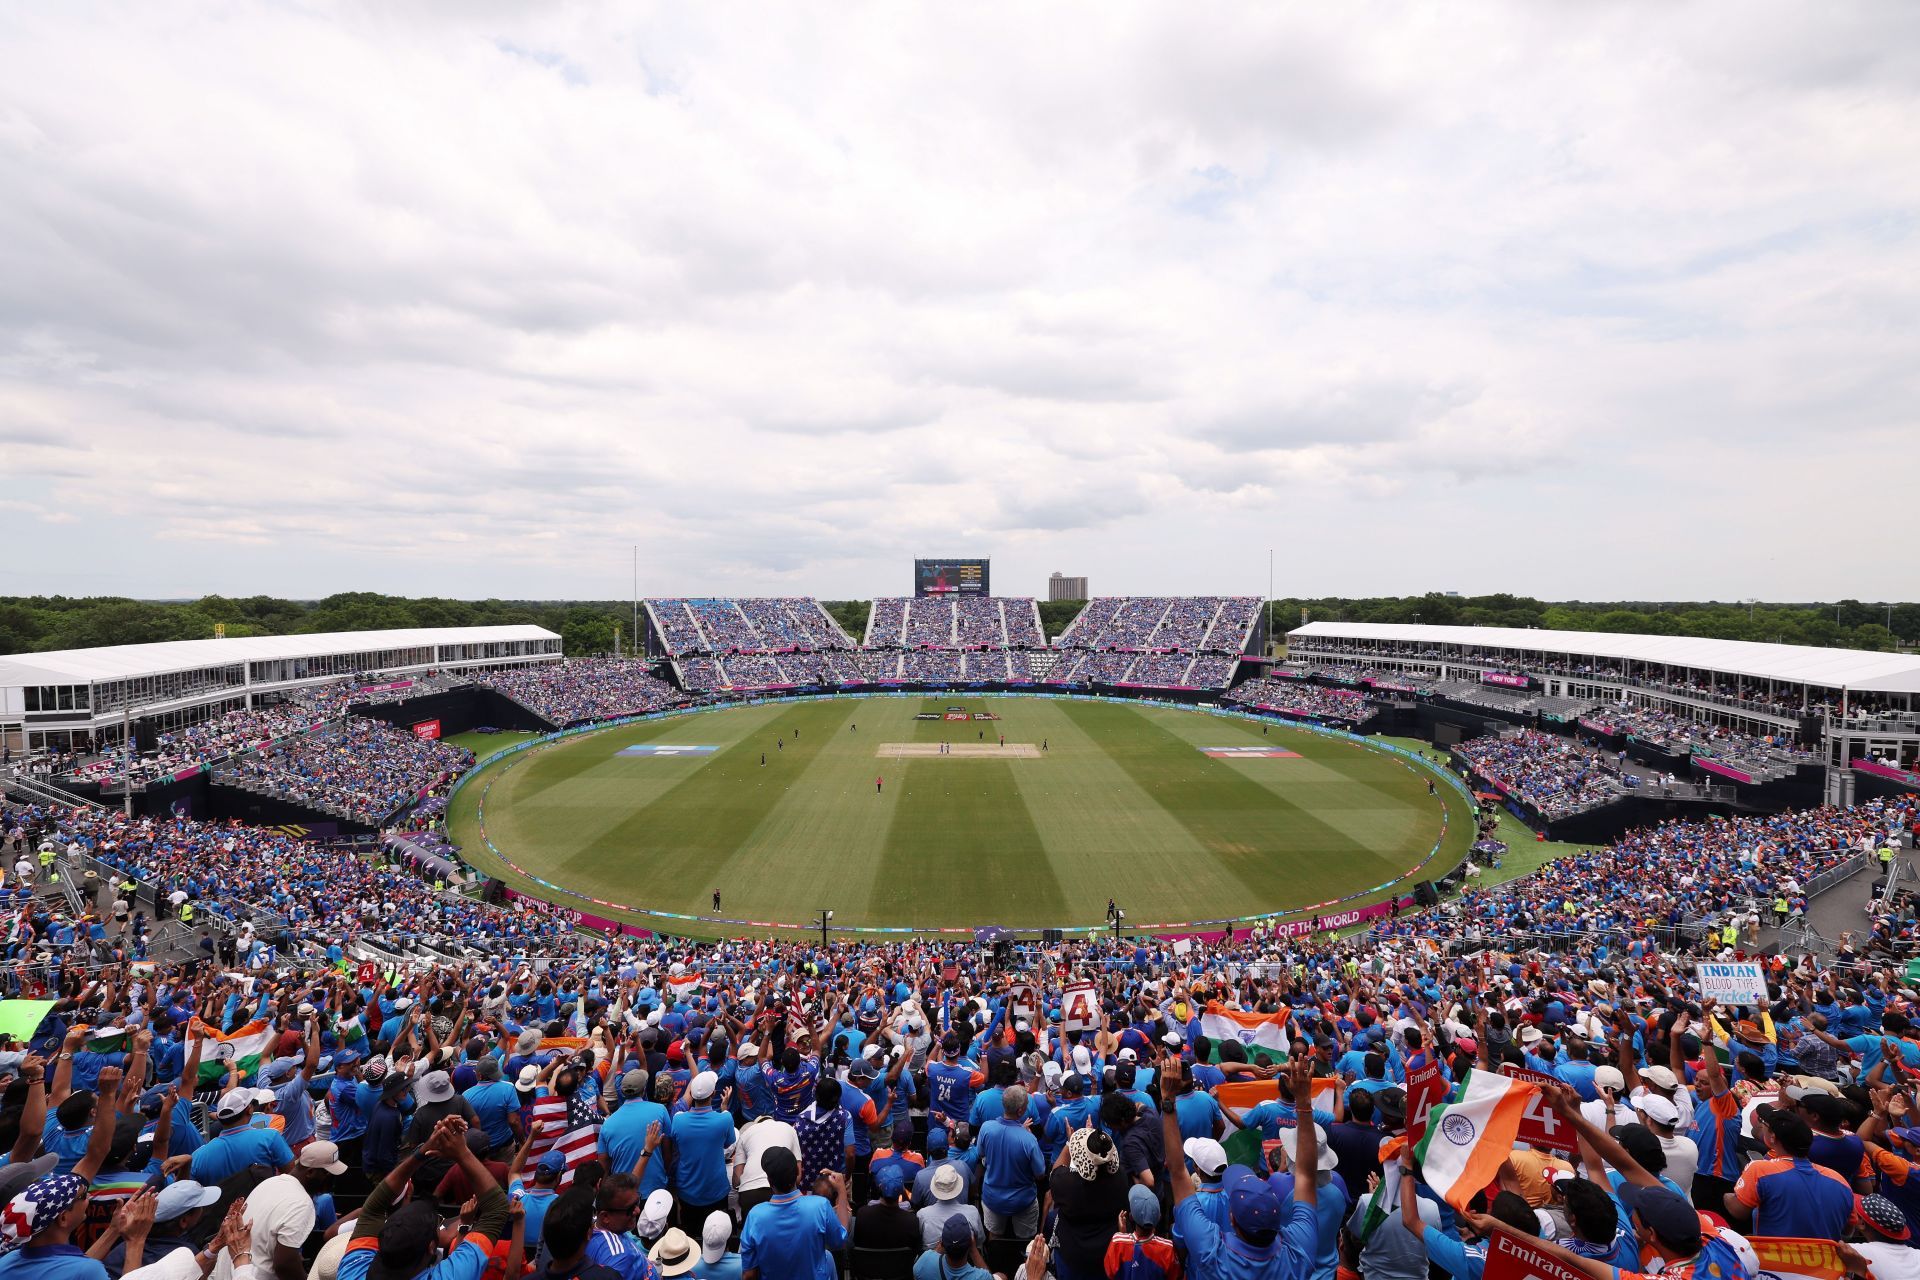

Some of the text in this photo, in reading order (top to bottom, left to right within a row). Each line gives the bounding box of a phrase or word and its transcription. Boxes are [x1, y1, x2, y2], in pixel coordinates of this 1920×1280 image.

[1491, 675, 1518, 685] NEW YORK
[417, 724, 436, 733] Emirates
[1279, 923, 1295, 936] OF
[1297, 919, 1322, 933] THS
[1323, 911, 1360, 929] WORLD
[362, 967, 370, 978] 4
[1058, 965, 1066, 974] 4
[1701, 965, 1757, 977] INDIAN
[1704, 977, 1758, 990] BLOOD TYPE:
[1017, 988, 1035, 1011] 4
[1068, 994, 1092, 1026] 4
[936, 1075, 957, 1085] VIJAY
[1410, 1065, 1438, 1086] Emirates
[938, 1083, 951, 1102] 24
[1413, 1086, 1432, 1128] 4
[1522, 1091, 1561, 1136] 4
[1276, 1116, 1297, 1127] GAUR
